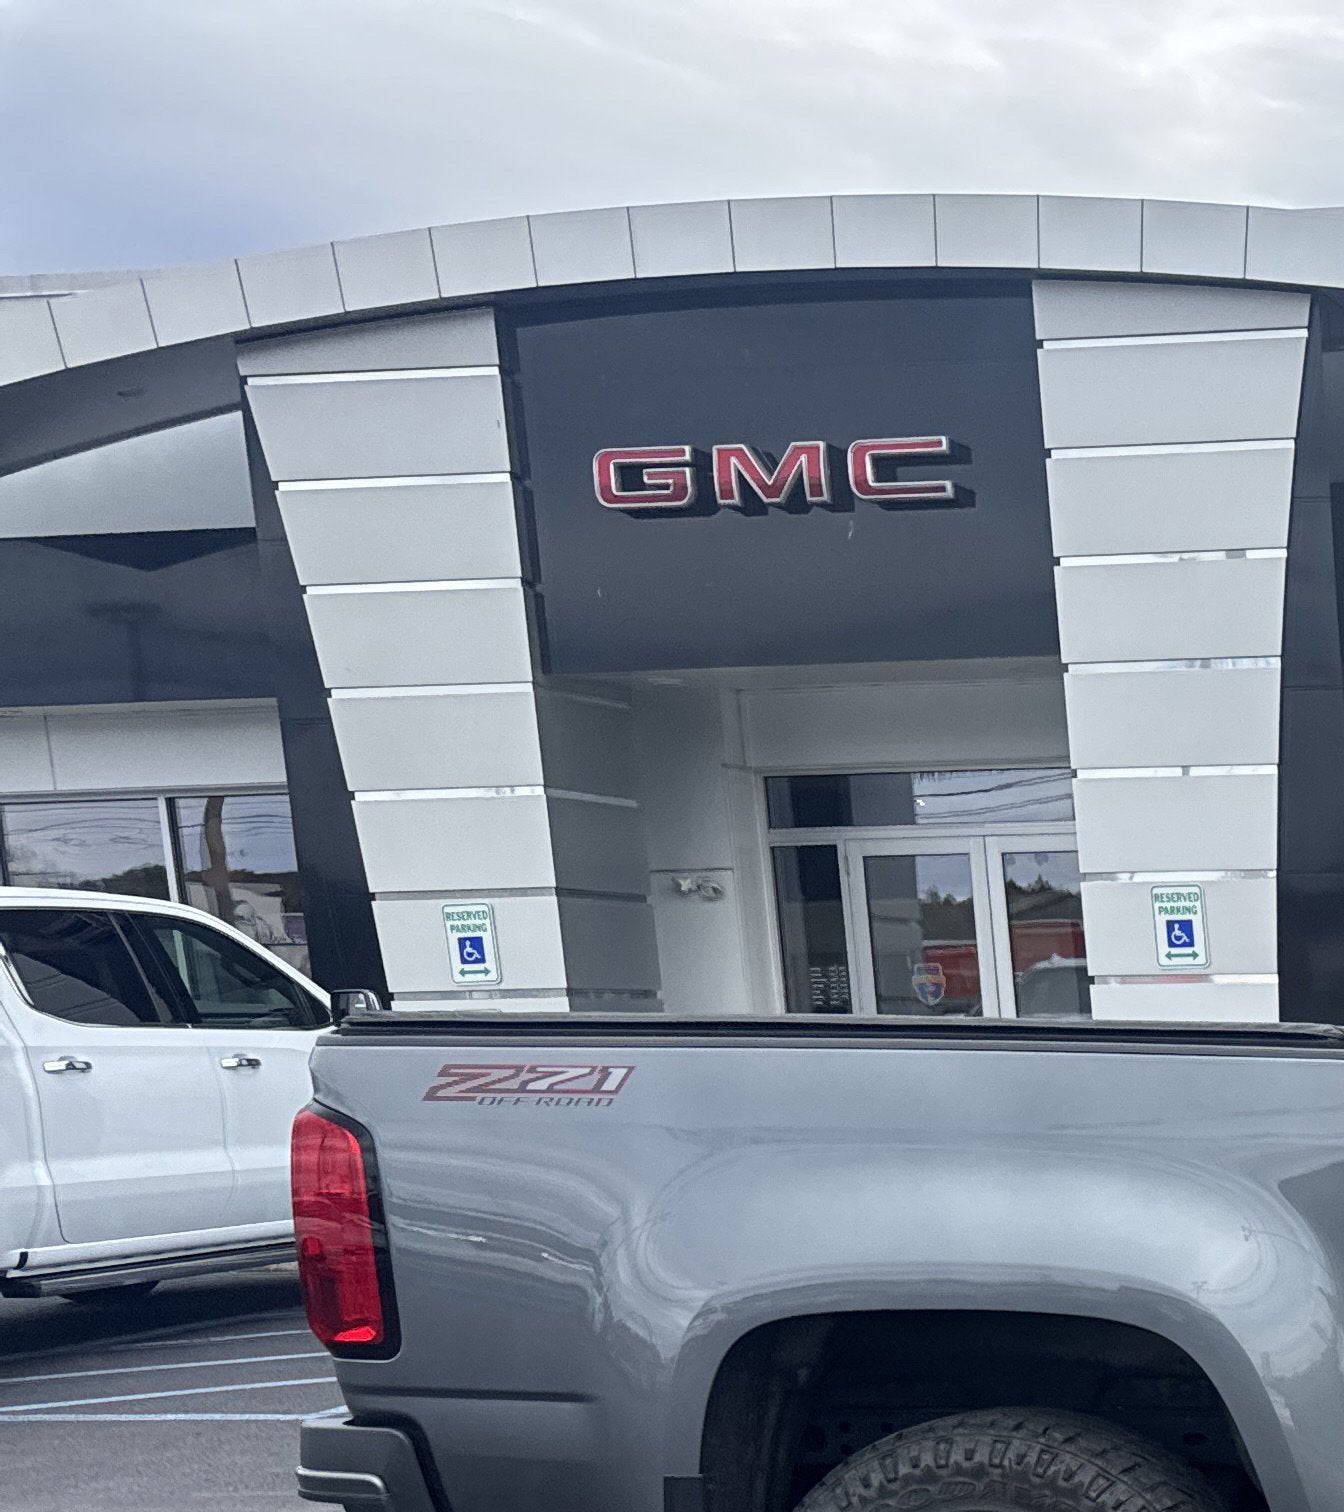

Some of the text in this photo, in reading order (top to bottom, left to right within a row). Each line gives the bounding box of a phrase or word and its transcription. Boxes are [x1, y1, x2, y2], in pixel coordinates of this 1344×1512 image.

[593, 435, 954, 508] GMC
[1153, 892, 1200, 903] RESERVED
[445, 910, 488, 921] RESERVED
[1158, 905, 1198, 915] PARKING
[450, 923, 487, 934] PARKING
[422, 1064, 636, 1101] Z71
[478, 1096, 614, 1107] OFF ROAD
